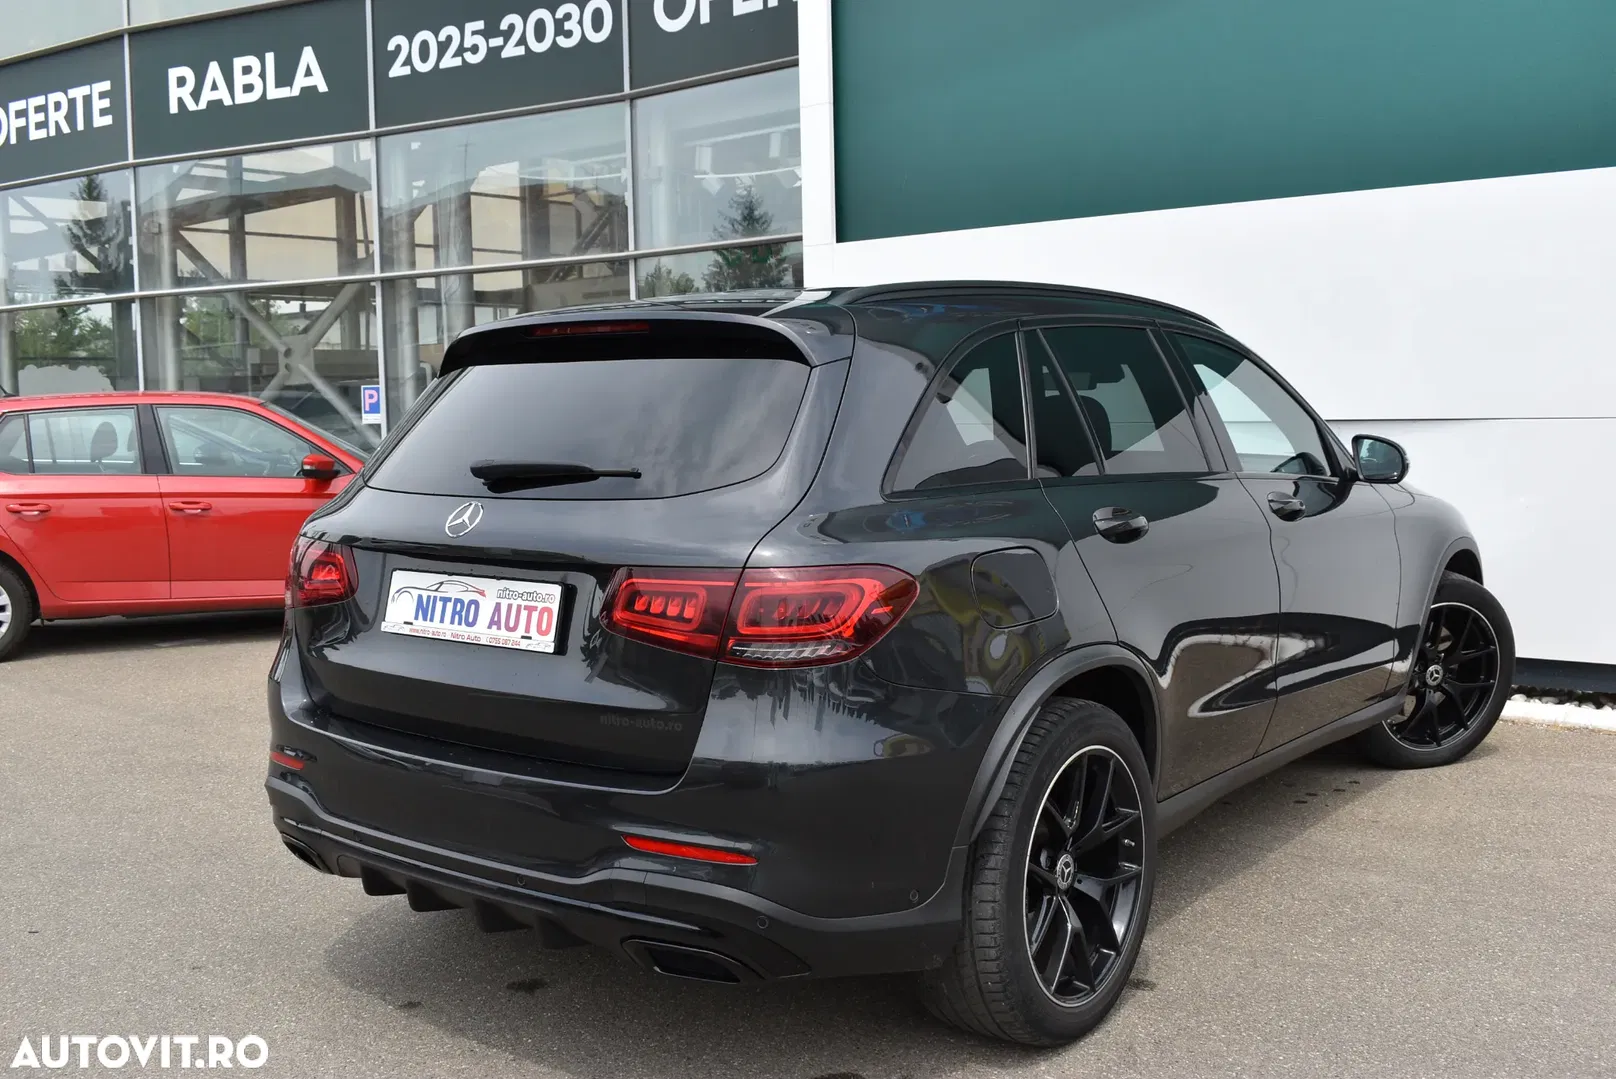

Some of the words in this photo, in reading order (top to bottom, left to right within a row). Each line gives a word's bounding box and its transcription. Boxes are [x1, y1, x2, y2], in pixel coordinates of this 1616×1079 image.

[168, 45, 329, 114] RABLA
[387, 0, 613, 78] 2025-2030
[364, 389, 379, 412] P
[496, 586, 556, 604] nitro-auto.ro
[414, 593, 480, 628] NITRO
[487, 601, 554, 637] AUTO
[450, 632, 466, 641] Nitro
[466, 634, 481, 642] Auto
[599, 713, 684, 732] nitro-auto.ro
